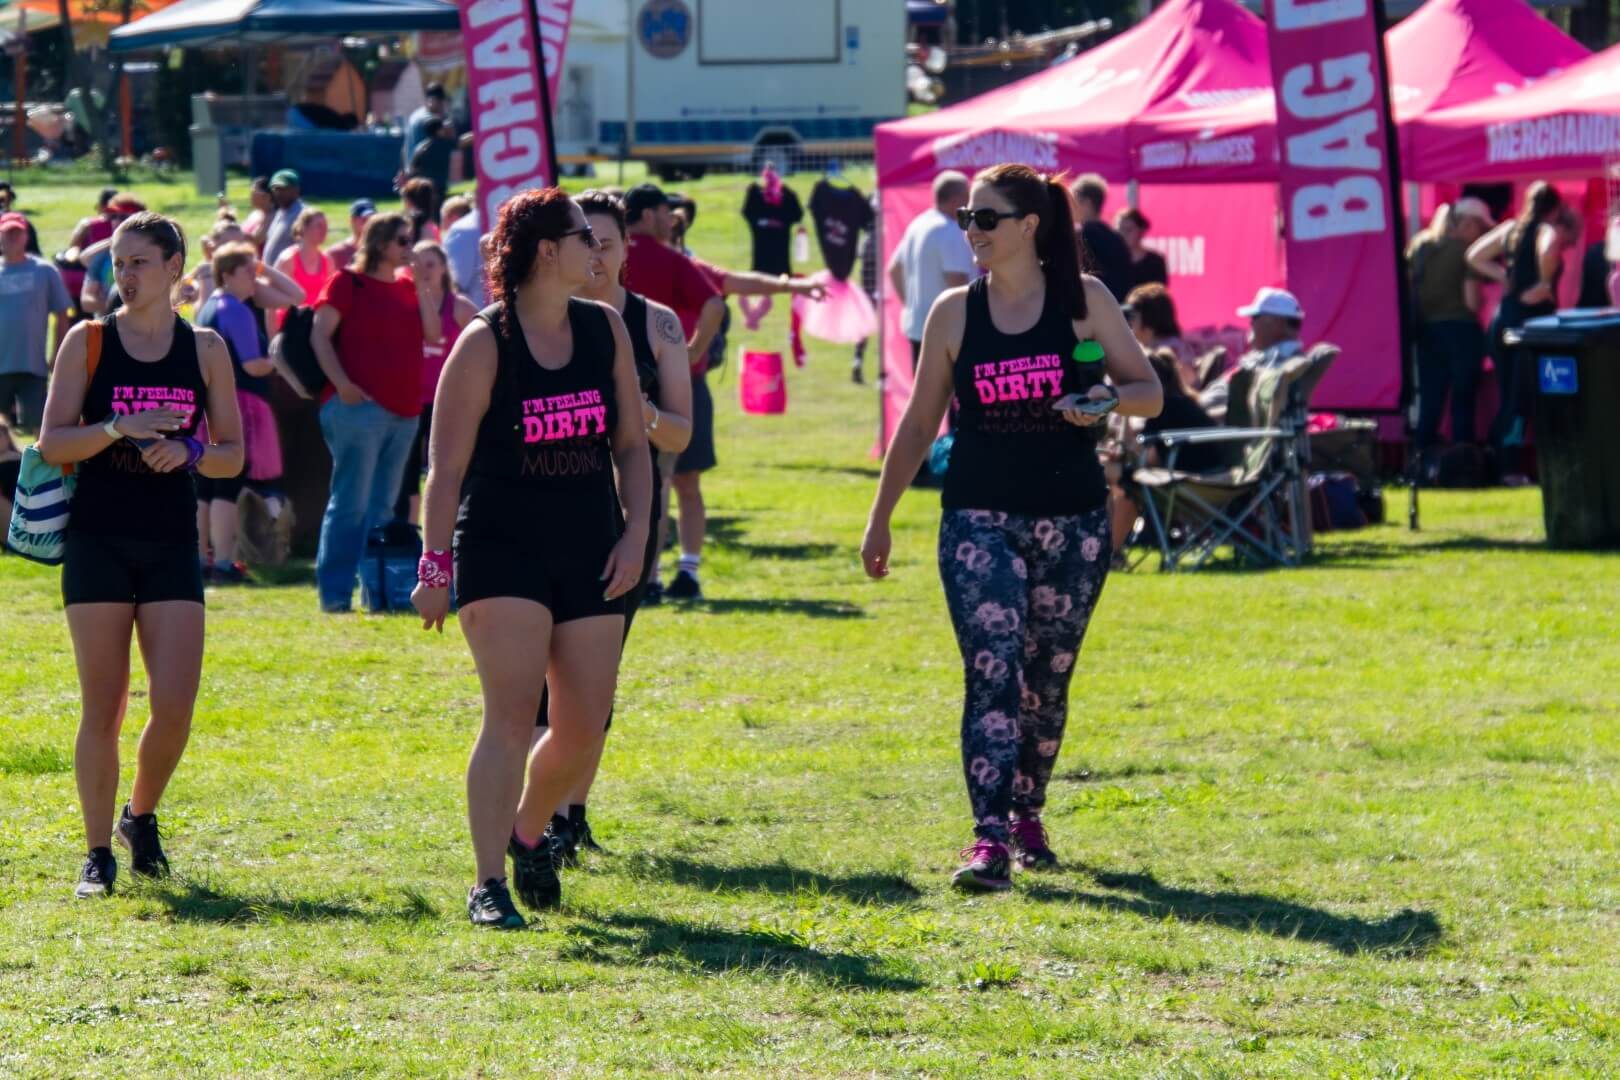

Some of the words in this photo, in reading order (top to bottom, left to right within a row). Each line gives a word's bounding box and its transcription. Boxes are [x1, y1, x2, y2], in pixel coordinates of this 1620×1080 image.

[1281, 51, 1386, 241] BAG
[974, 362, 997, 379] I'M
[998, 354, 1062, 375] FEELING
[112, 386, 135, 400] I'M
[137, 386, 196, 402] FEELING
[522, 398, 546, 415] I'M
[545, 389, 602, 411] FEELING
[974, 369, 1065, 405] DIRTY
[522, 405, 607, 444] DIRTY
